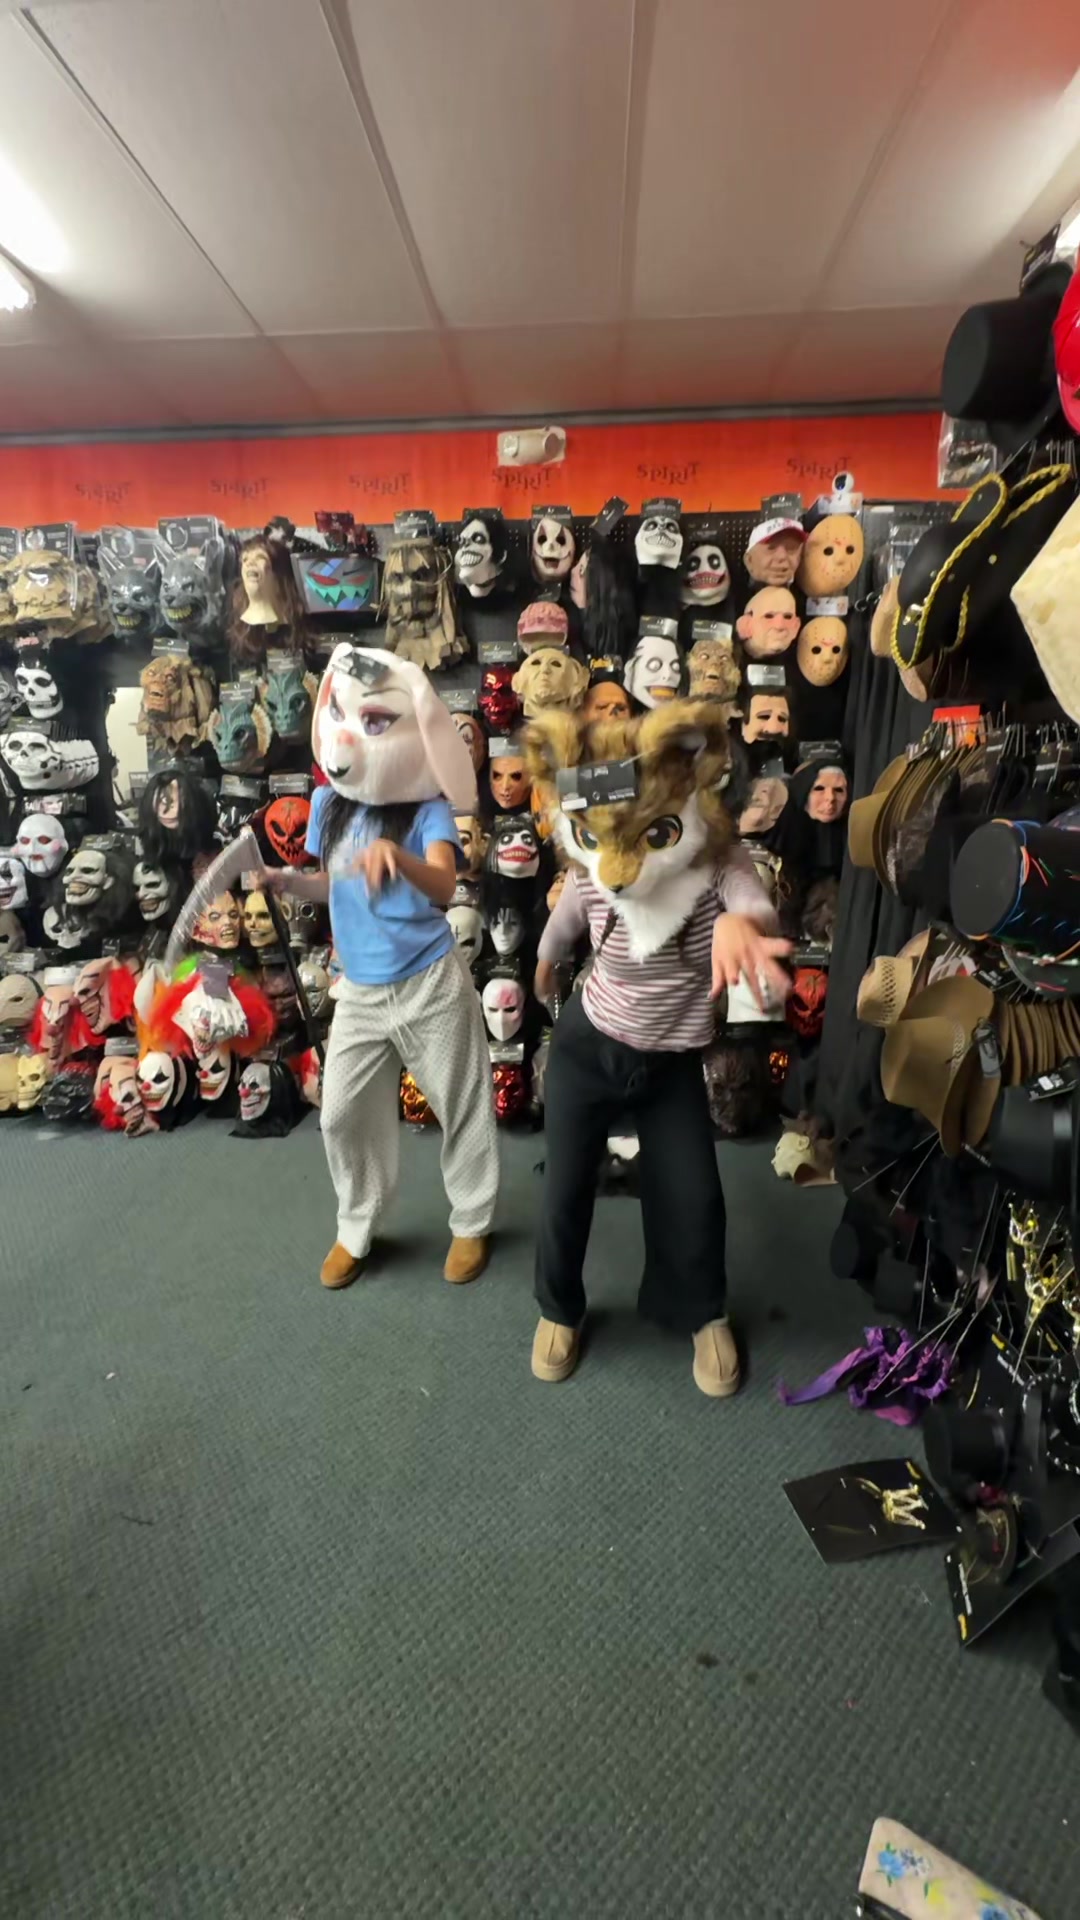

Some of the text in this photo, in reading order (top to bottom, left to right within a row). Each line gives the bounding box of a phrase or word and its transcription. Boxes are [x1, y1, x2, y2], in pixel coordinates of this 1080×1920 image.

[492, 467, 551, 491] SPIRIT
[637, 461, 702, 485] SPIRIT
[787, 456, 850, 481] SPIRIT
[349, 472, 410, 495] SPIRIT
